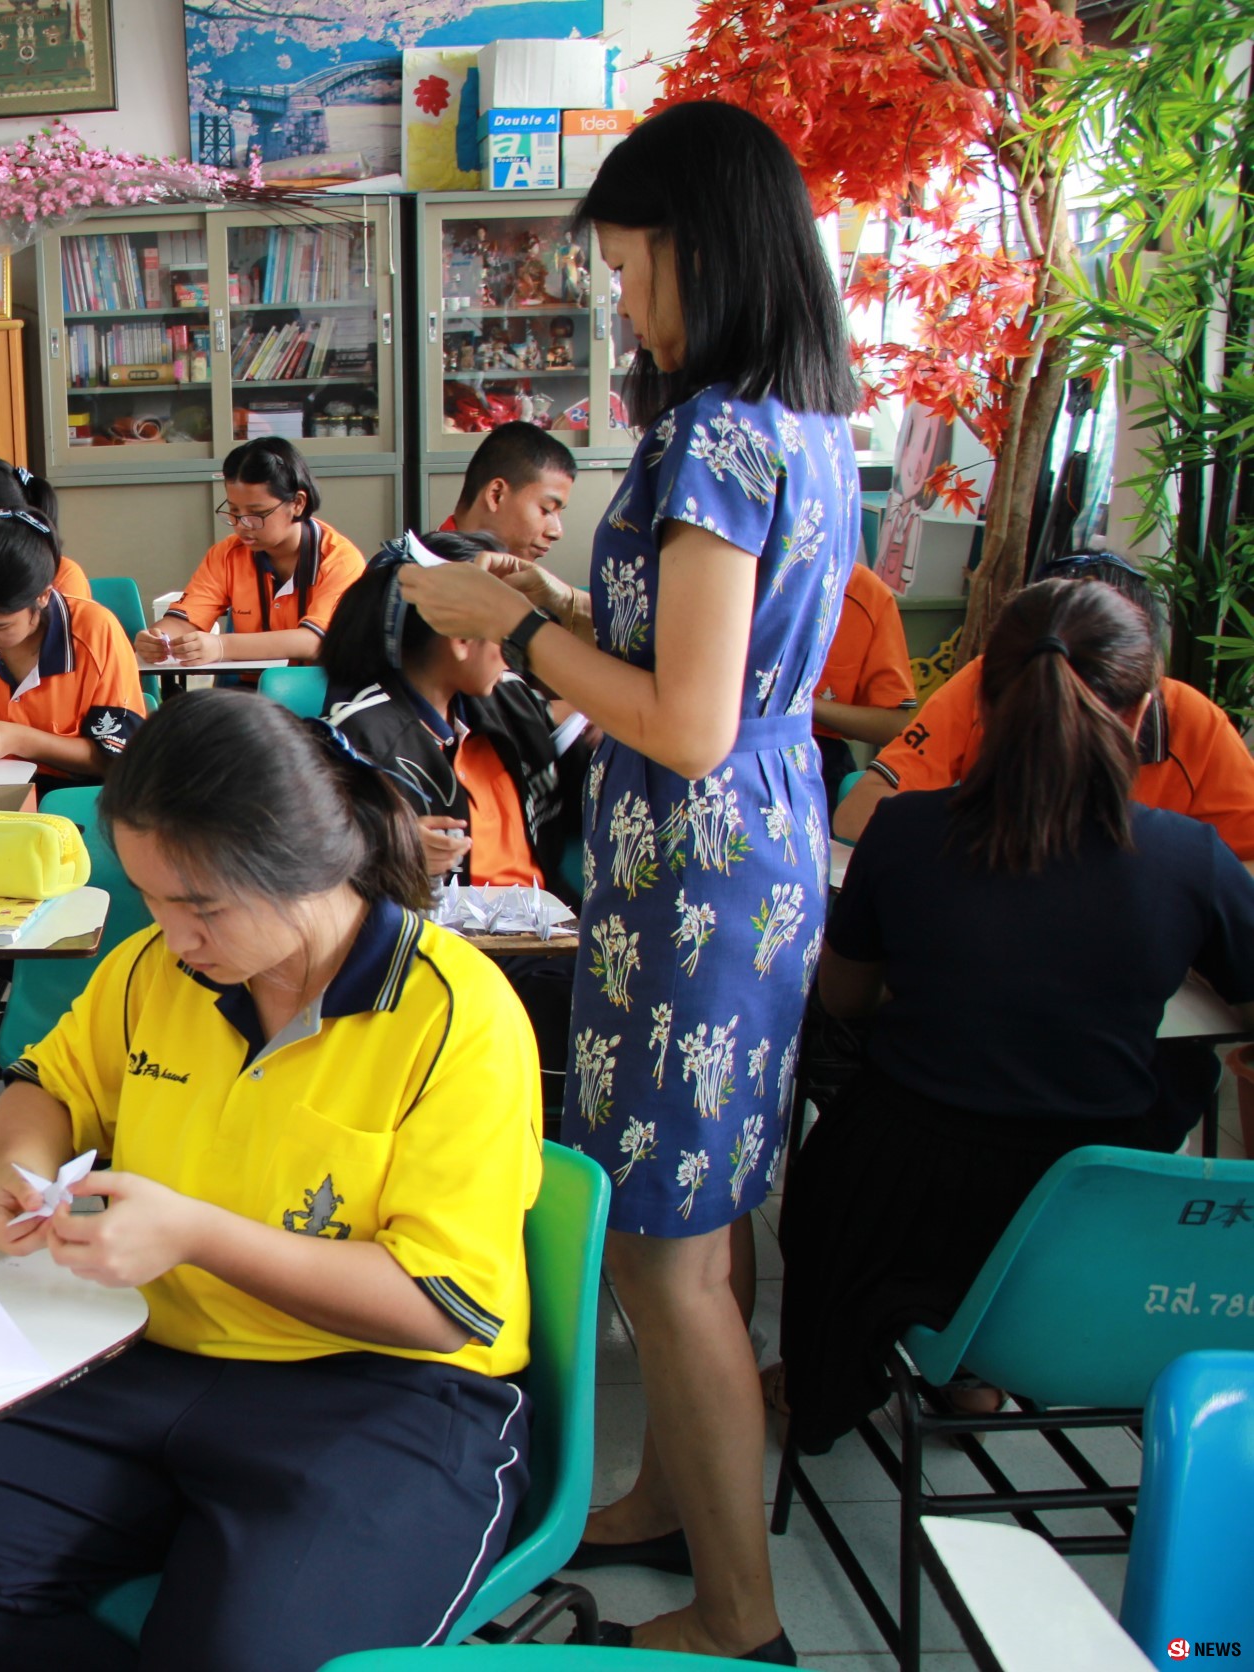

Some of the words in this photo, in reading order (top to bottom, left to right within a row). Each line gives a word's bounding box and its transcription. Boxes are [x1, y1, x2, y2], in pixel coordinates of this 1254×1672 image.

[494, 115, 542, 127] Double
[546, 114, 556, 125] A
[580, 115, 618, 131] idea
